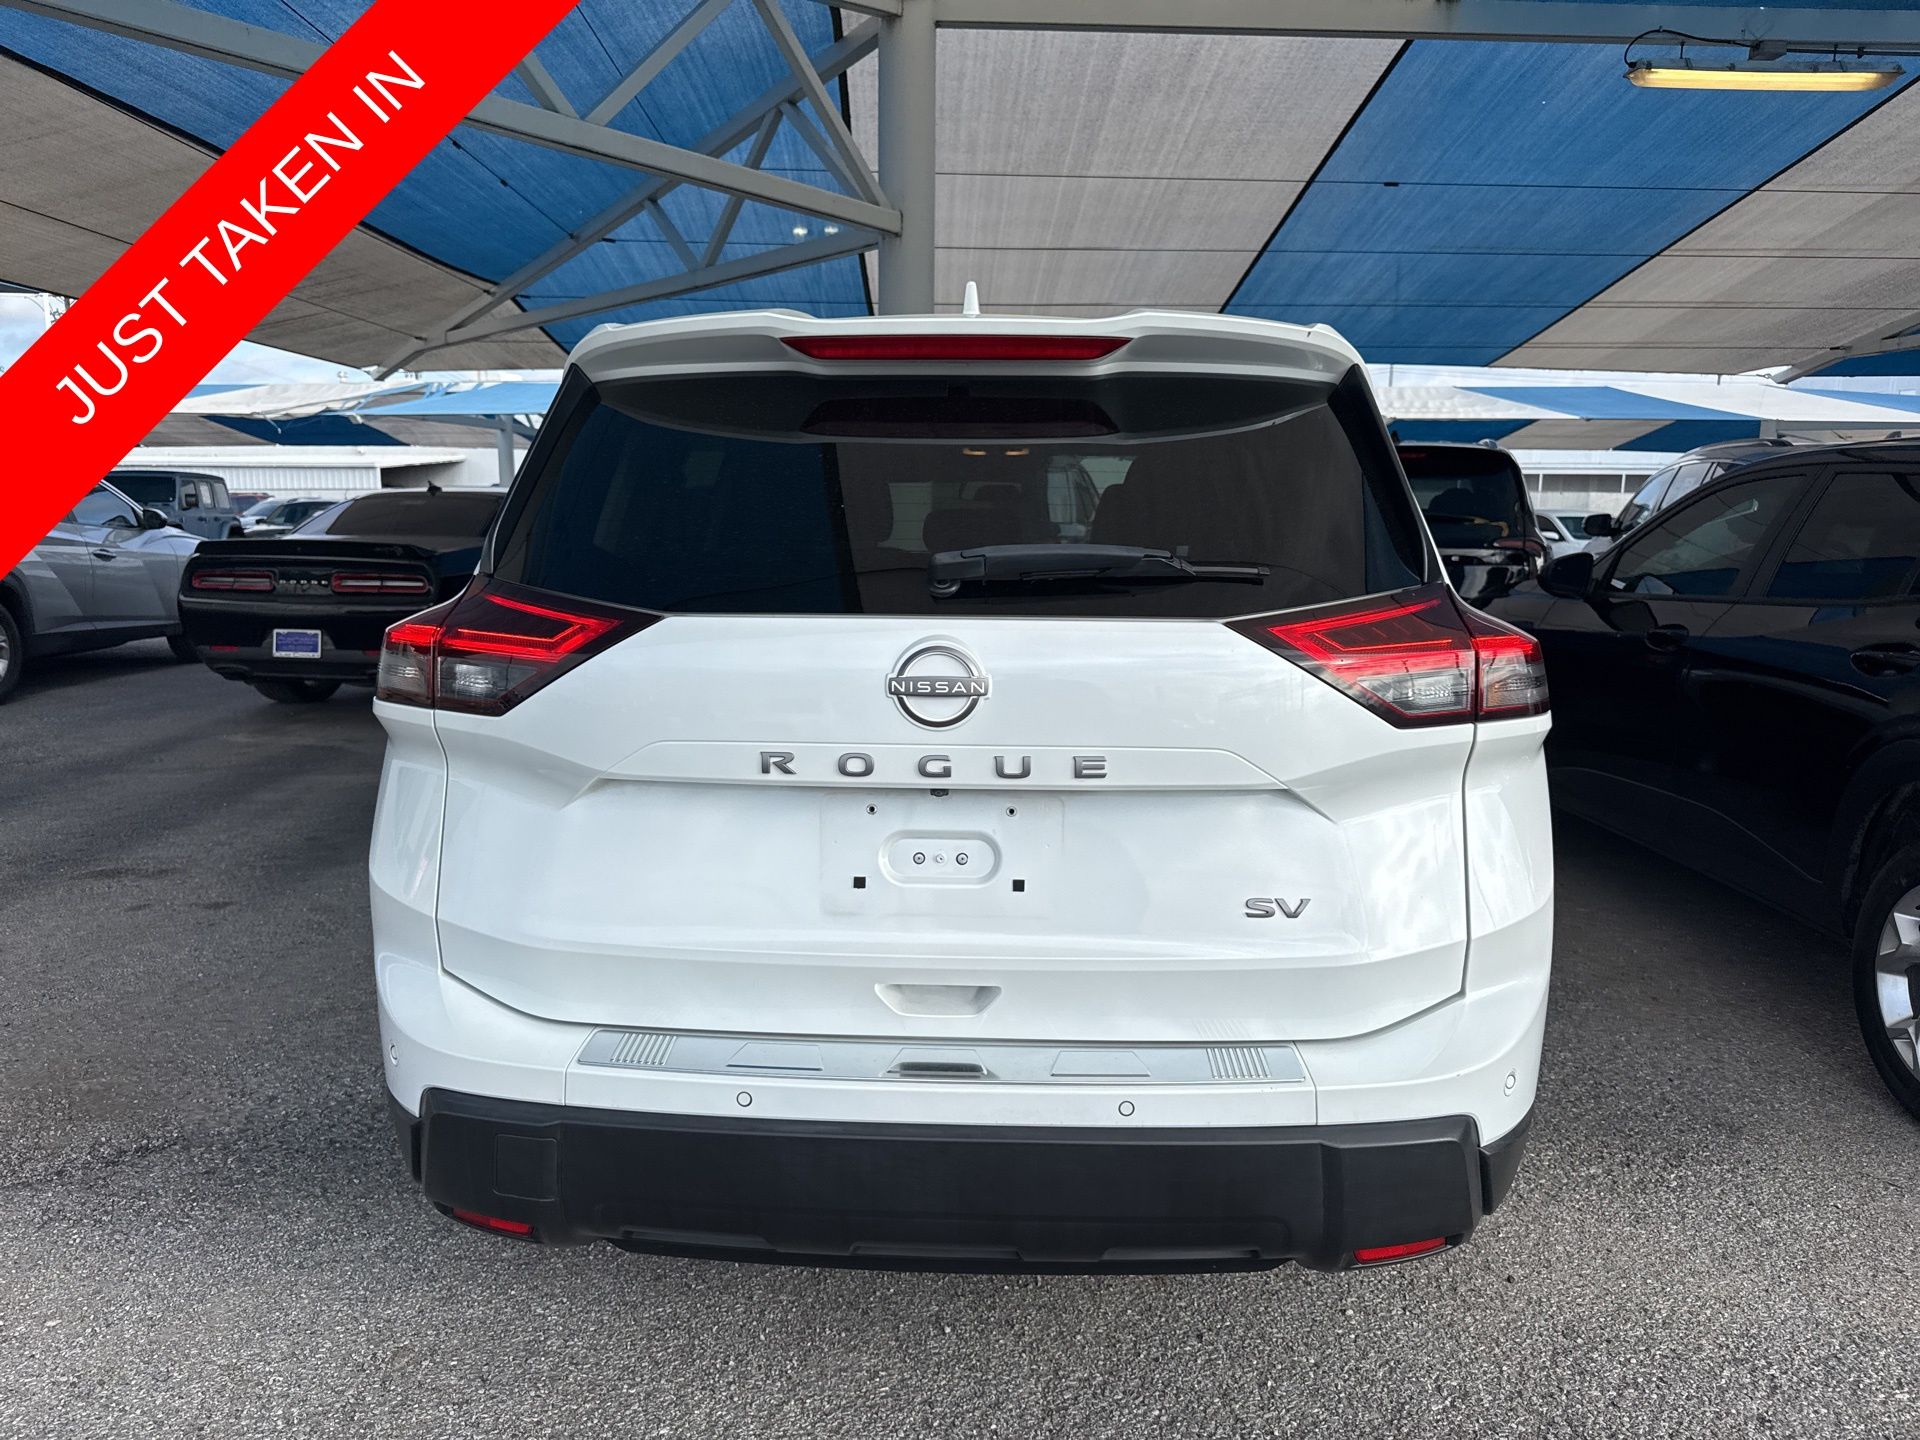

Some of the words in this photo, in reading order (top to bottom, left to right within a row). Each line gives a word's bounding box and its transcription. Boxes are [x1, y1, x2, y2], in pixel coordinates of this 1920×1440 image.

[891, 679, 986, 695] NISSAN
[760, 751, 1108, 779] ROGUE
[1244, 897, 1312, 919] SV
